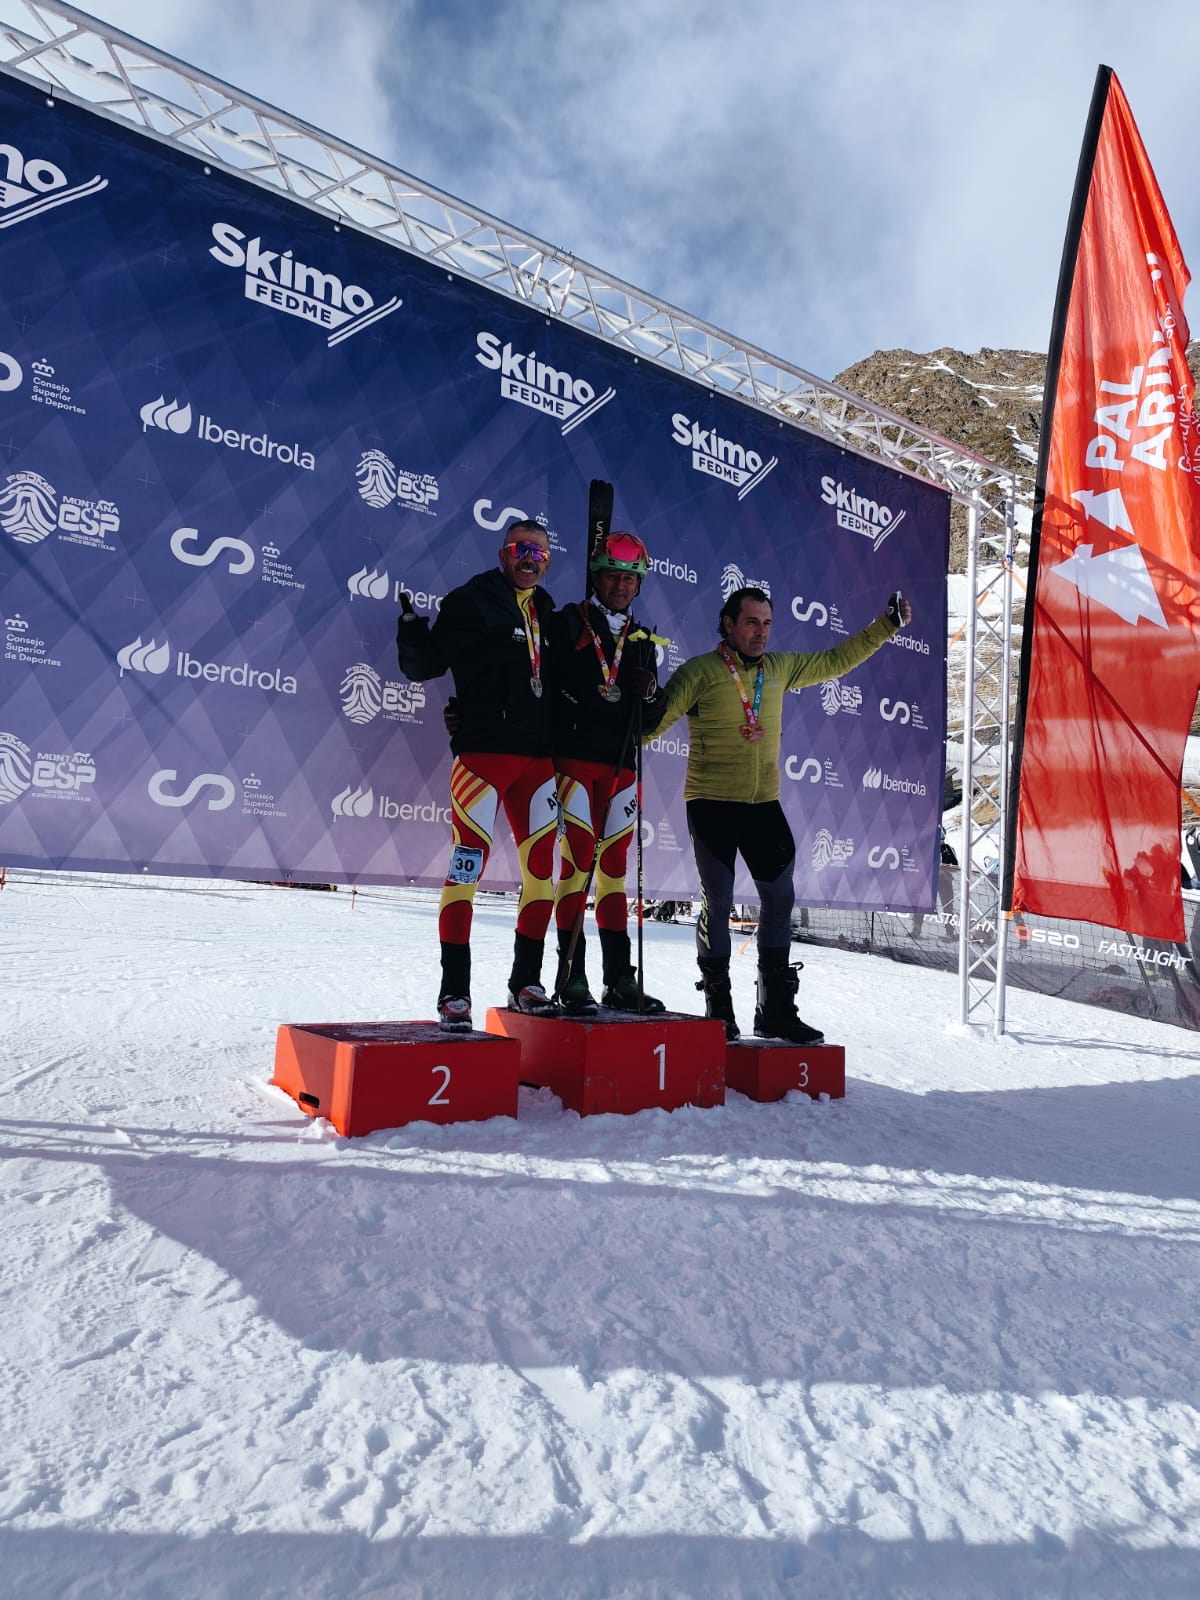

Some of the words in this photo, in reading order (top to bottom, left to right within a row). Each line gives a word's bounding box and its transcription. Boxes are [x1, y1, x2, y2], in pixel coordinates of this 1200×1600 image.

[208, 222, 375, 316] Skimo
[256, 285, 333, 325] FEDME
[474, 331, 595, 405] Skimo
[32, 385, 72, 402] Superior
[33, 377, 70, 393] Consejo
[31, 394, 43, 403] de
[45, 397, 87, 415] Deportes
[509, 384, 565, 416] FEDME
[1085, 365, 1145, 472] PAL
[198, 414, 316, 471] Iberdrola
[670, 412, 763, 473] Skimo
[699, 457, 740, 484] FEDME
[820, 475, 893, 527] Skimo
[841, 513, 875, 536] FEDME
[647, 557, 698, 585] erdrola
[6, 633, 45, 647] Consejo
[6, 642, 47, 655] Superior
[4, 651, 17, 660] de
[18, 653, 62, 667] Deportes
[176, 652, 298, 694] Iberdrola
[882, 773, 927, 796] Iberdrola
[455, 857, 475, 872] 30
[1098, 940, 1193, 970] FAST&LIGHT
[652, 1043, 667, 1091] 1
[798, 1062, 809, 1088] 3
[429, 1065, 452, 1105] 2
